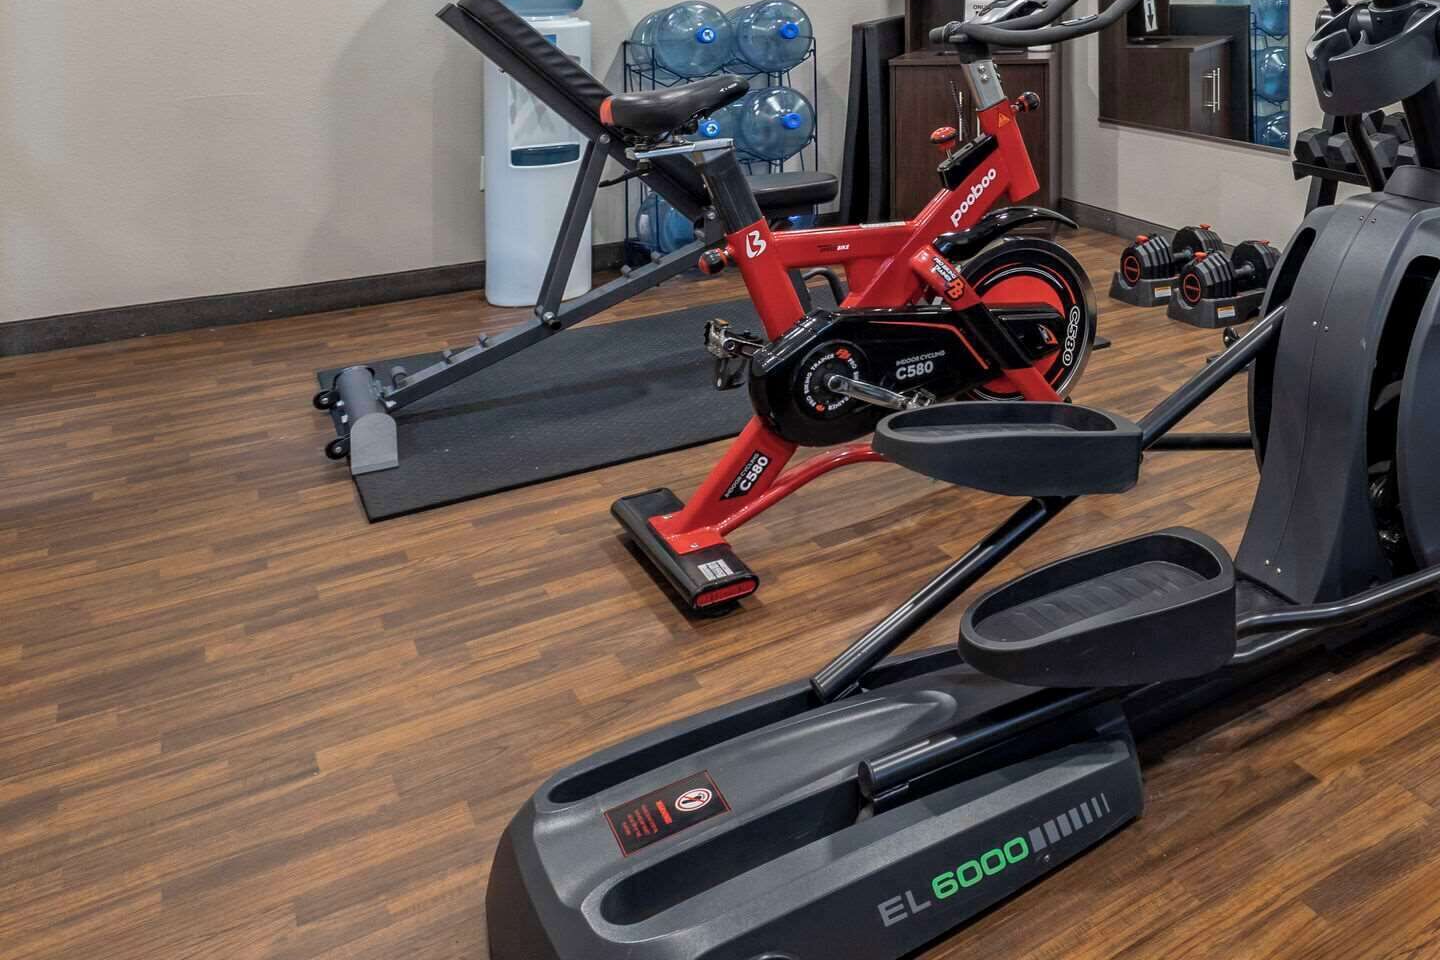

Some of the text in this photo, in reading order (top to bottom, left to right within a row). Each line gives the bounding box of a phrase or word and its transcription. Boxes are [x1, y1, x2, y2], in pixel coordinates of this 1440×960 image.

[950, 167, 997, 228] pooboo
[1062, 305, 1080, 367] C580
[895, 360, 934, 380] C580
[919, 349, 946, 361] CYCLING
[740, 456, 769, 491] C580
